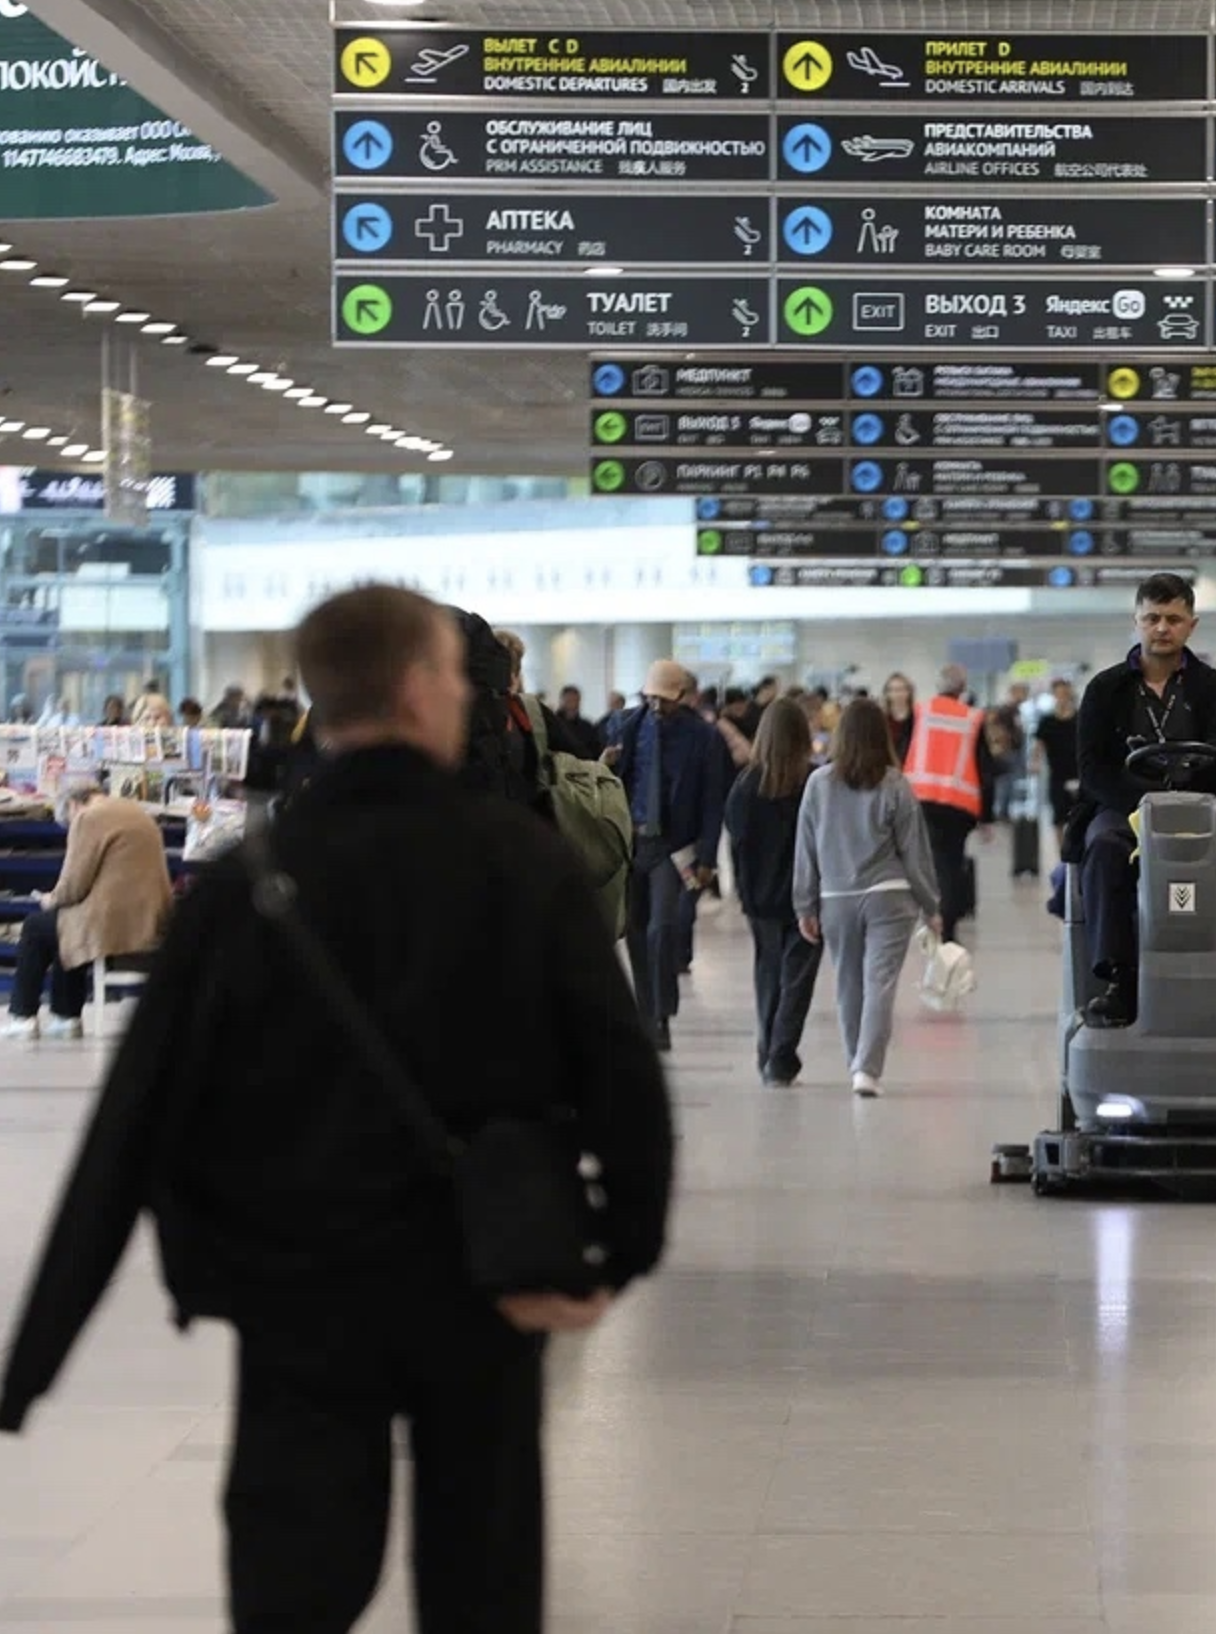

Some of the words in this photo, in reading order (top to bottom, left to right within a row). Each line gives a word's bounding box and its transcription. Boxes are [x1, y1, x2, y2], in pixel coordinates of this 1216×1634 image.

[483, 38, 536, 54] ВЫЛЕТ
[566, 38, 579, 54] D
[925, 42, 986, 57] ПРИЛЕТ
[998, 42, 1010, 57] D
[483, 57, 585, 73] ВНУТРЕННИЕ
[589, 58, 687, 73] АВИАЛИНИИ
[925, 61, 1026, 76] ВНУТРЕННИЕ
[1029, 61, 1127, 76] АВИАЛИНИИ
[484, 77, 556, 93] DOMESTIC
[559, 77, 648, 93] DEPARTURES
[741, 82, 749, 94] 2
[925, 79, 997, 94] DOMESTIC
[999, 79, 1065, 95] ARRIVALS
[486, 120, 614, 137] ОБСЛУЖИВАНИЕ
[617, 121, 653, 139] ЛИЦ
[925, 123, 1093, 140] ПРЕДСТАВИТЕЛЬСТВА
[486, 140, 495, 155] С
[500, 137, 630, 156] ОГРАНИЧЕННОЙ
[632, 140, 766, 158] ПОДВИЖНОСТЬЮ
[925, 139, 1056, 158] АВИАКОМПАНИЙ
[486, 159, 518, 174] PRM
[520, 159, 603, 174] ASSISTANCE
[925, 162, 980, 177] AIRLINE
[983, 162, 1040, 177] OFFICES
[486, 211, 575, 230] АПТЕКА
[925, 206, 1002, 220] КОМНАТА
[925, 225, 989, 239] МАТЕРИ
[992, 225, 1004, 239] И
[1007, 225, 1076, 239] РЕБЕНКА
[486, 240, 564, 255] PHARMACY
[744, 244, 752, 256] 2
[925, 244, 961, 258] BABY
[964, 244, 1001, 258] CARE
[1003, 244, 1046, 258] ROOM
[587, 293, 672, 313] ТУАЛЕТ
[925, 295, 1008, 316] ВЫХОД
[1012, 295, 1026, 314] 3
[1046, 295, 1110, 315] Яндекс
[1116, 295, 1142, 314] Go
[861, 305, 895, 318] EXIT
[587, 321, 635, 336] TOILET
[742, 326, 750, 337] 2
[925, 325, 956, 338] EXIT
[971, 325, 999, 339] 出口
[1047, 325, 1078, 338] TAXI
